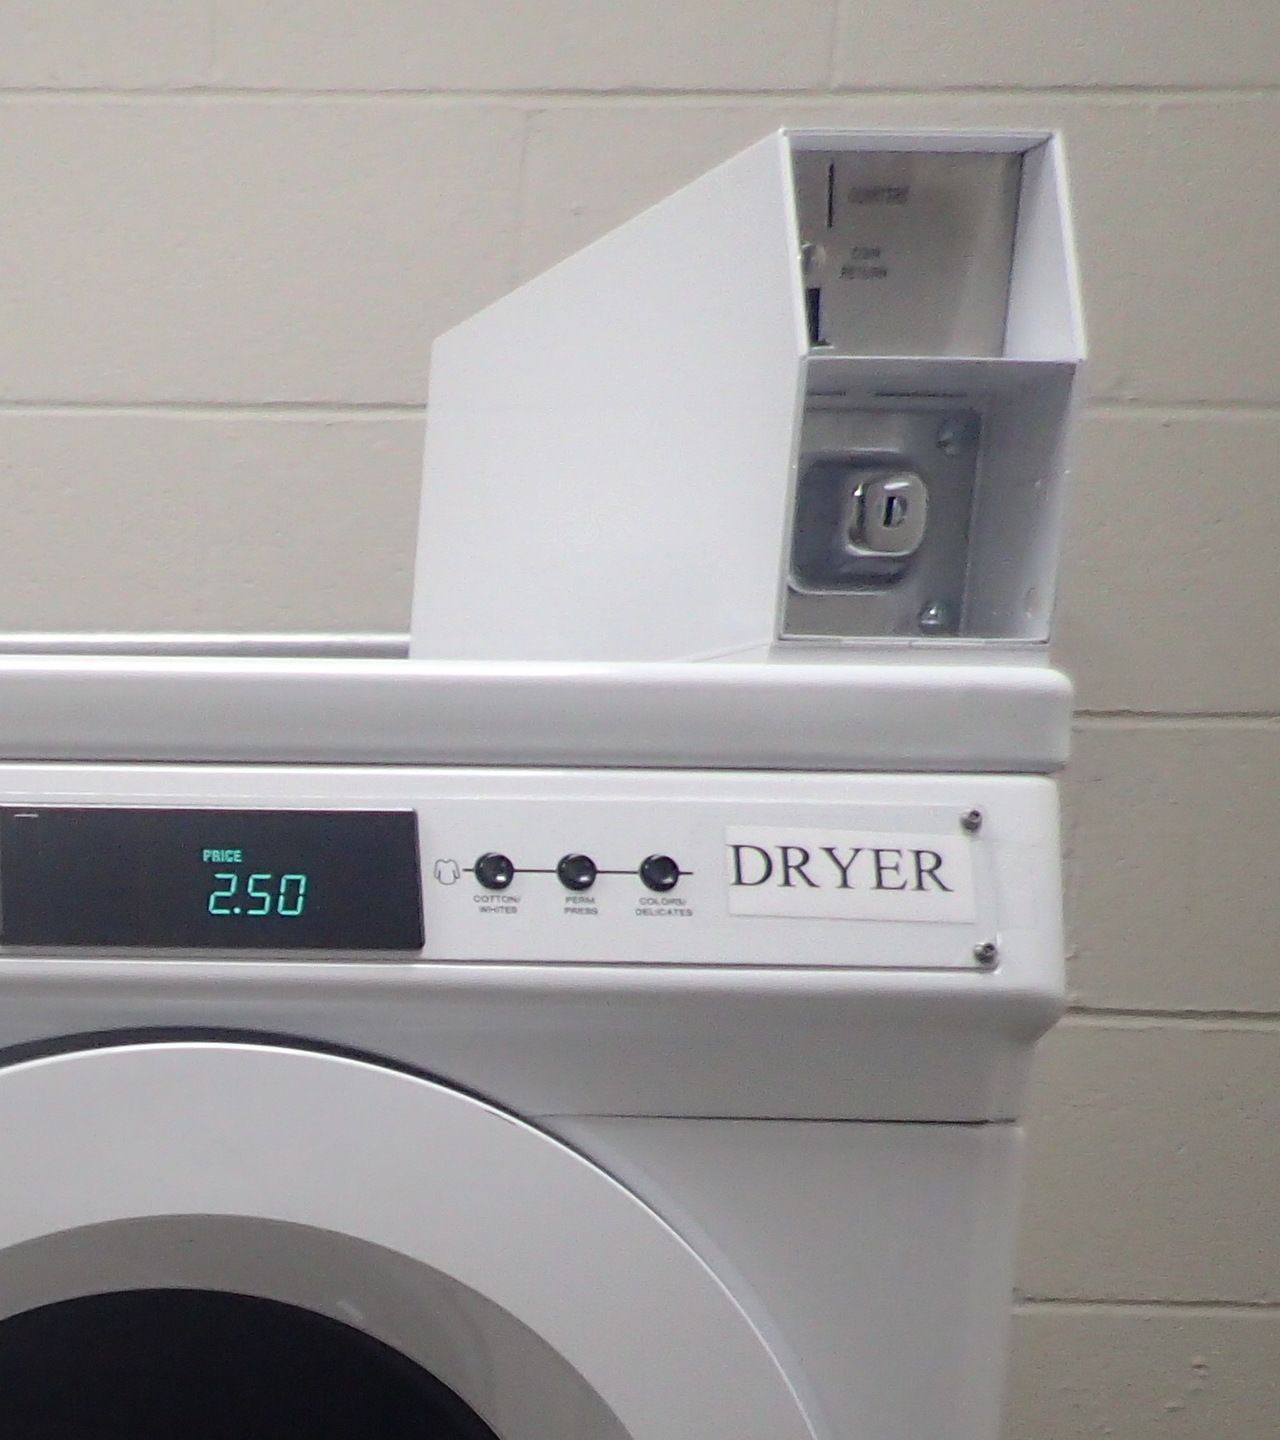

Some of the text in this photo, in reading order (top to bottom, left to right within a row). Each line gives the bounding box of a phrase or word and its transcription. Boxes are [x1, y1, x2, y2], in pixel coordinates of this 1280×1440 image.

[202, 849, 242, 862] PRICE
[729, 843, 955, 894] DRYER
[208, 873, 307, 915] 2.50
[479, 905, 518, 915] WHITES
[564, 907, 599, 916] PRESS
[635, 908, 694, 918] DELICATES
